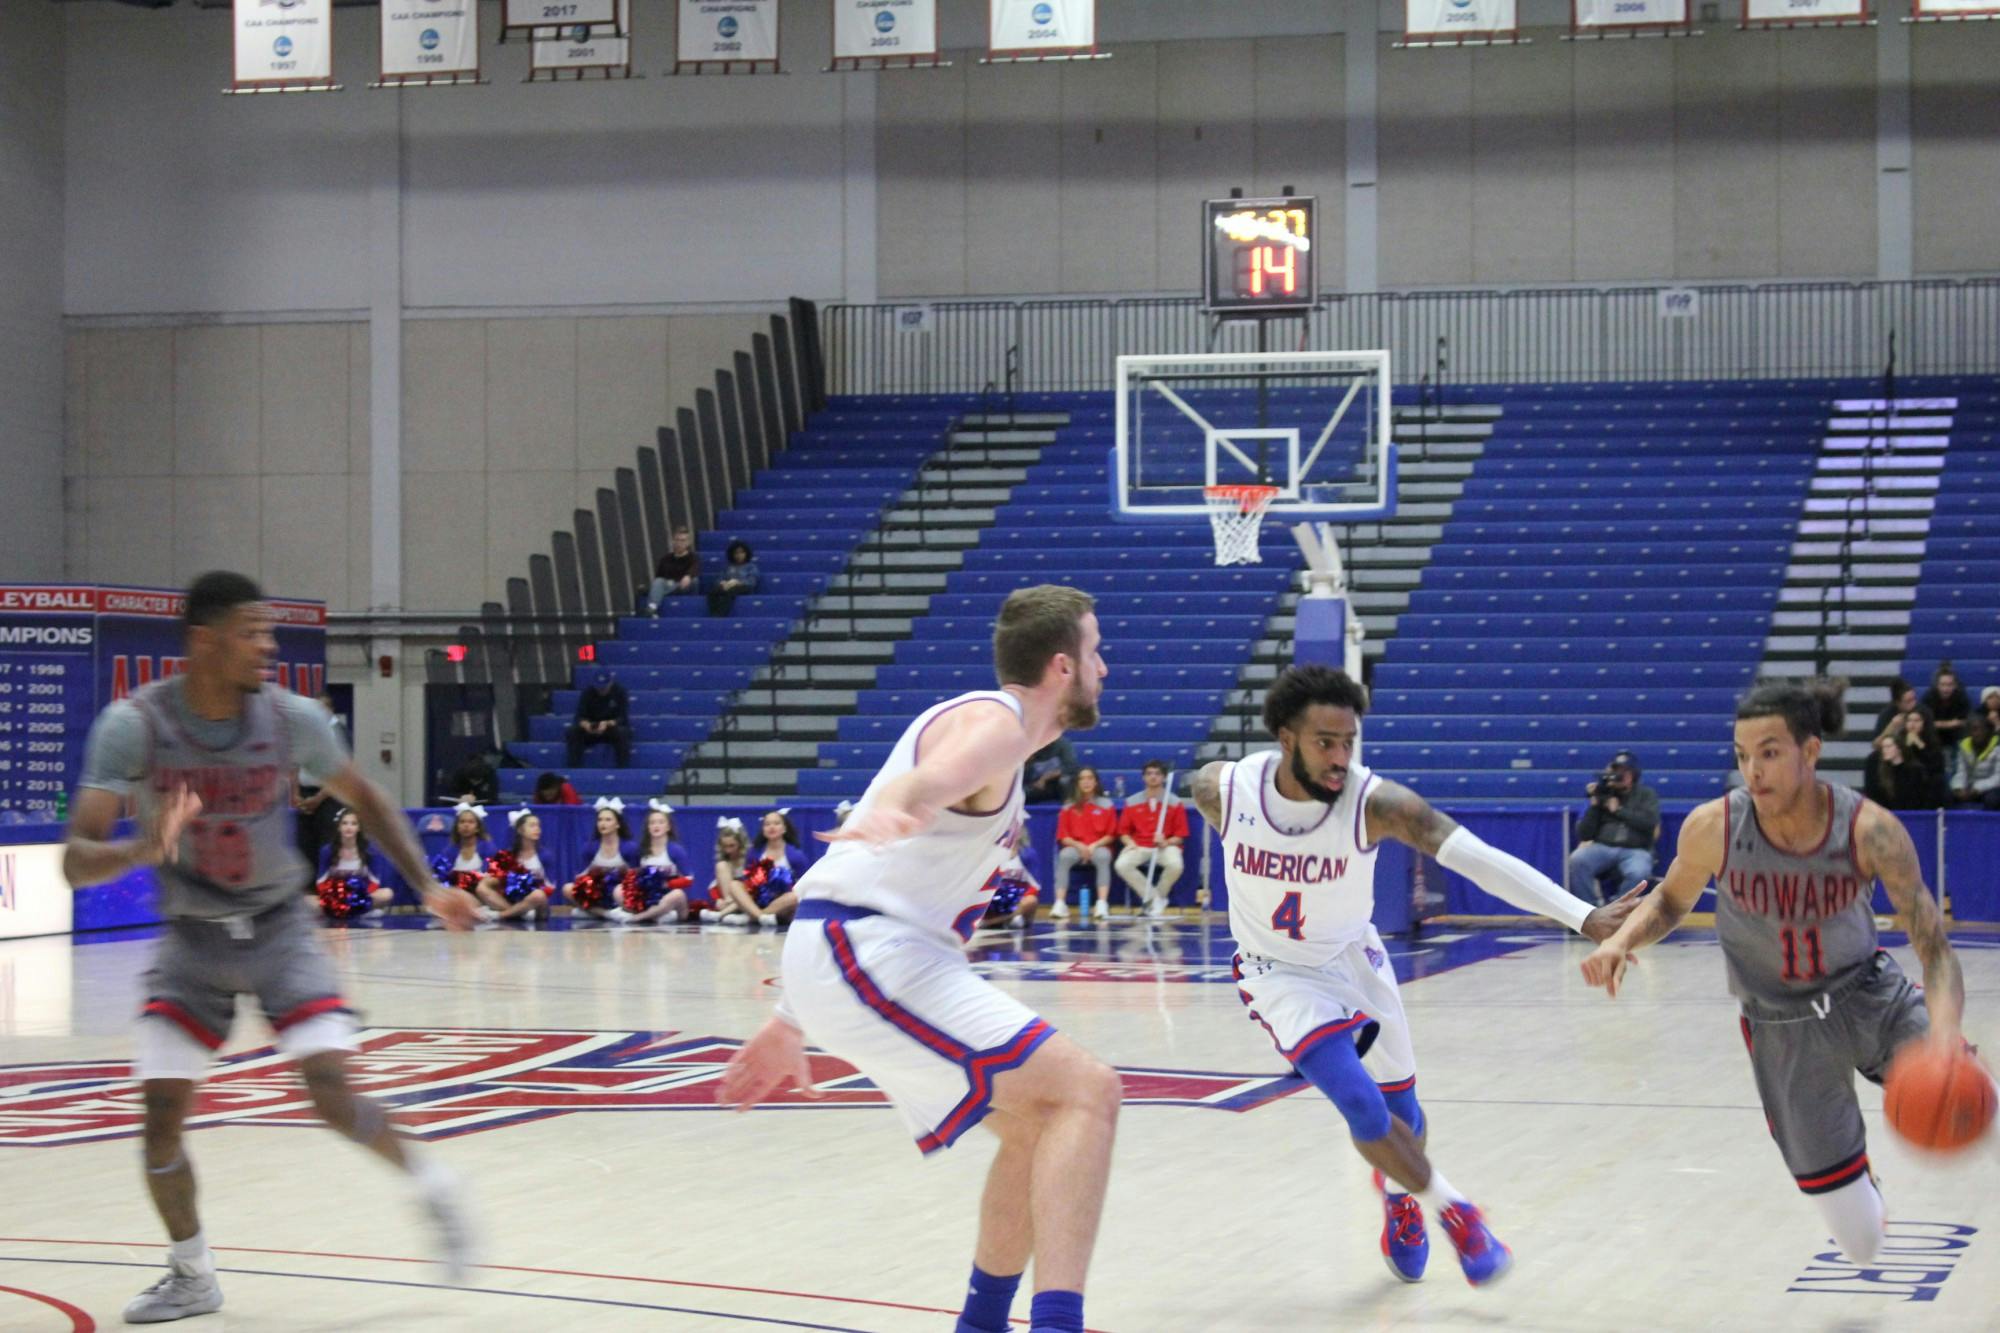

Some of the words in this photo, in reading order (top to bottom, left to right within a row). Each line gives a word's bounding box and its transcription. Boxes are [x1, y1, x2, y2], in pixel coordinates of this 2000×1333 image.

[412, 10, 465, 18] CHAMPIONS
[543, 5, 577, 17] 2017
[265, 18, 319, 26] CHAMPIONS
[1250, 245, 1295, 296] 14
[105, 594, 168, 611] CHARACTER
[28, 684, 63, 694] 2001
[28, 703, 65, 714] 2003
[28, 722, 65, 733] 2005
[28, 742, 64, 752] 2007
[28, 761, 65, 772] 2010
[27, 781, 64, 790] 2013
[1232, 842, 1349, 884] AMERICAN
[1729, 868, 1858, 920] HOWARD
[1271, 891, 1306, 941] 4
[1778, 925, 1826, 983] 11
